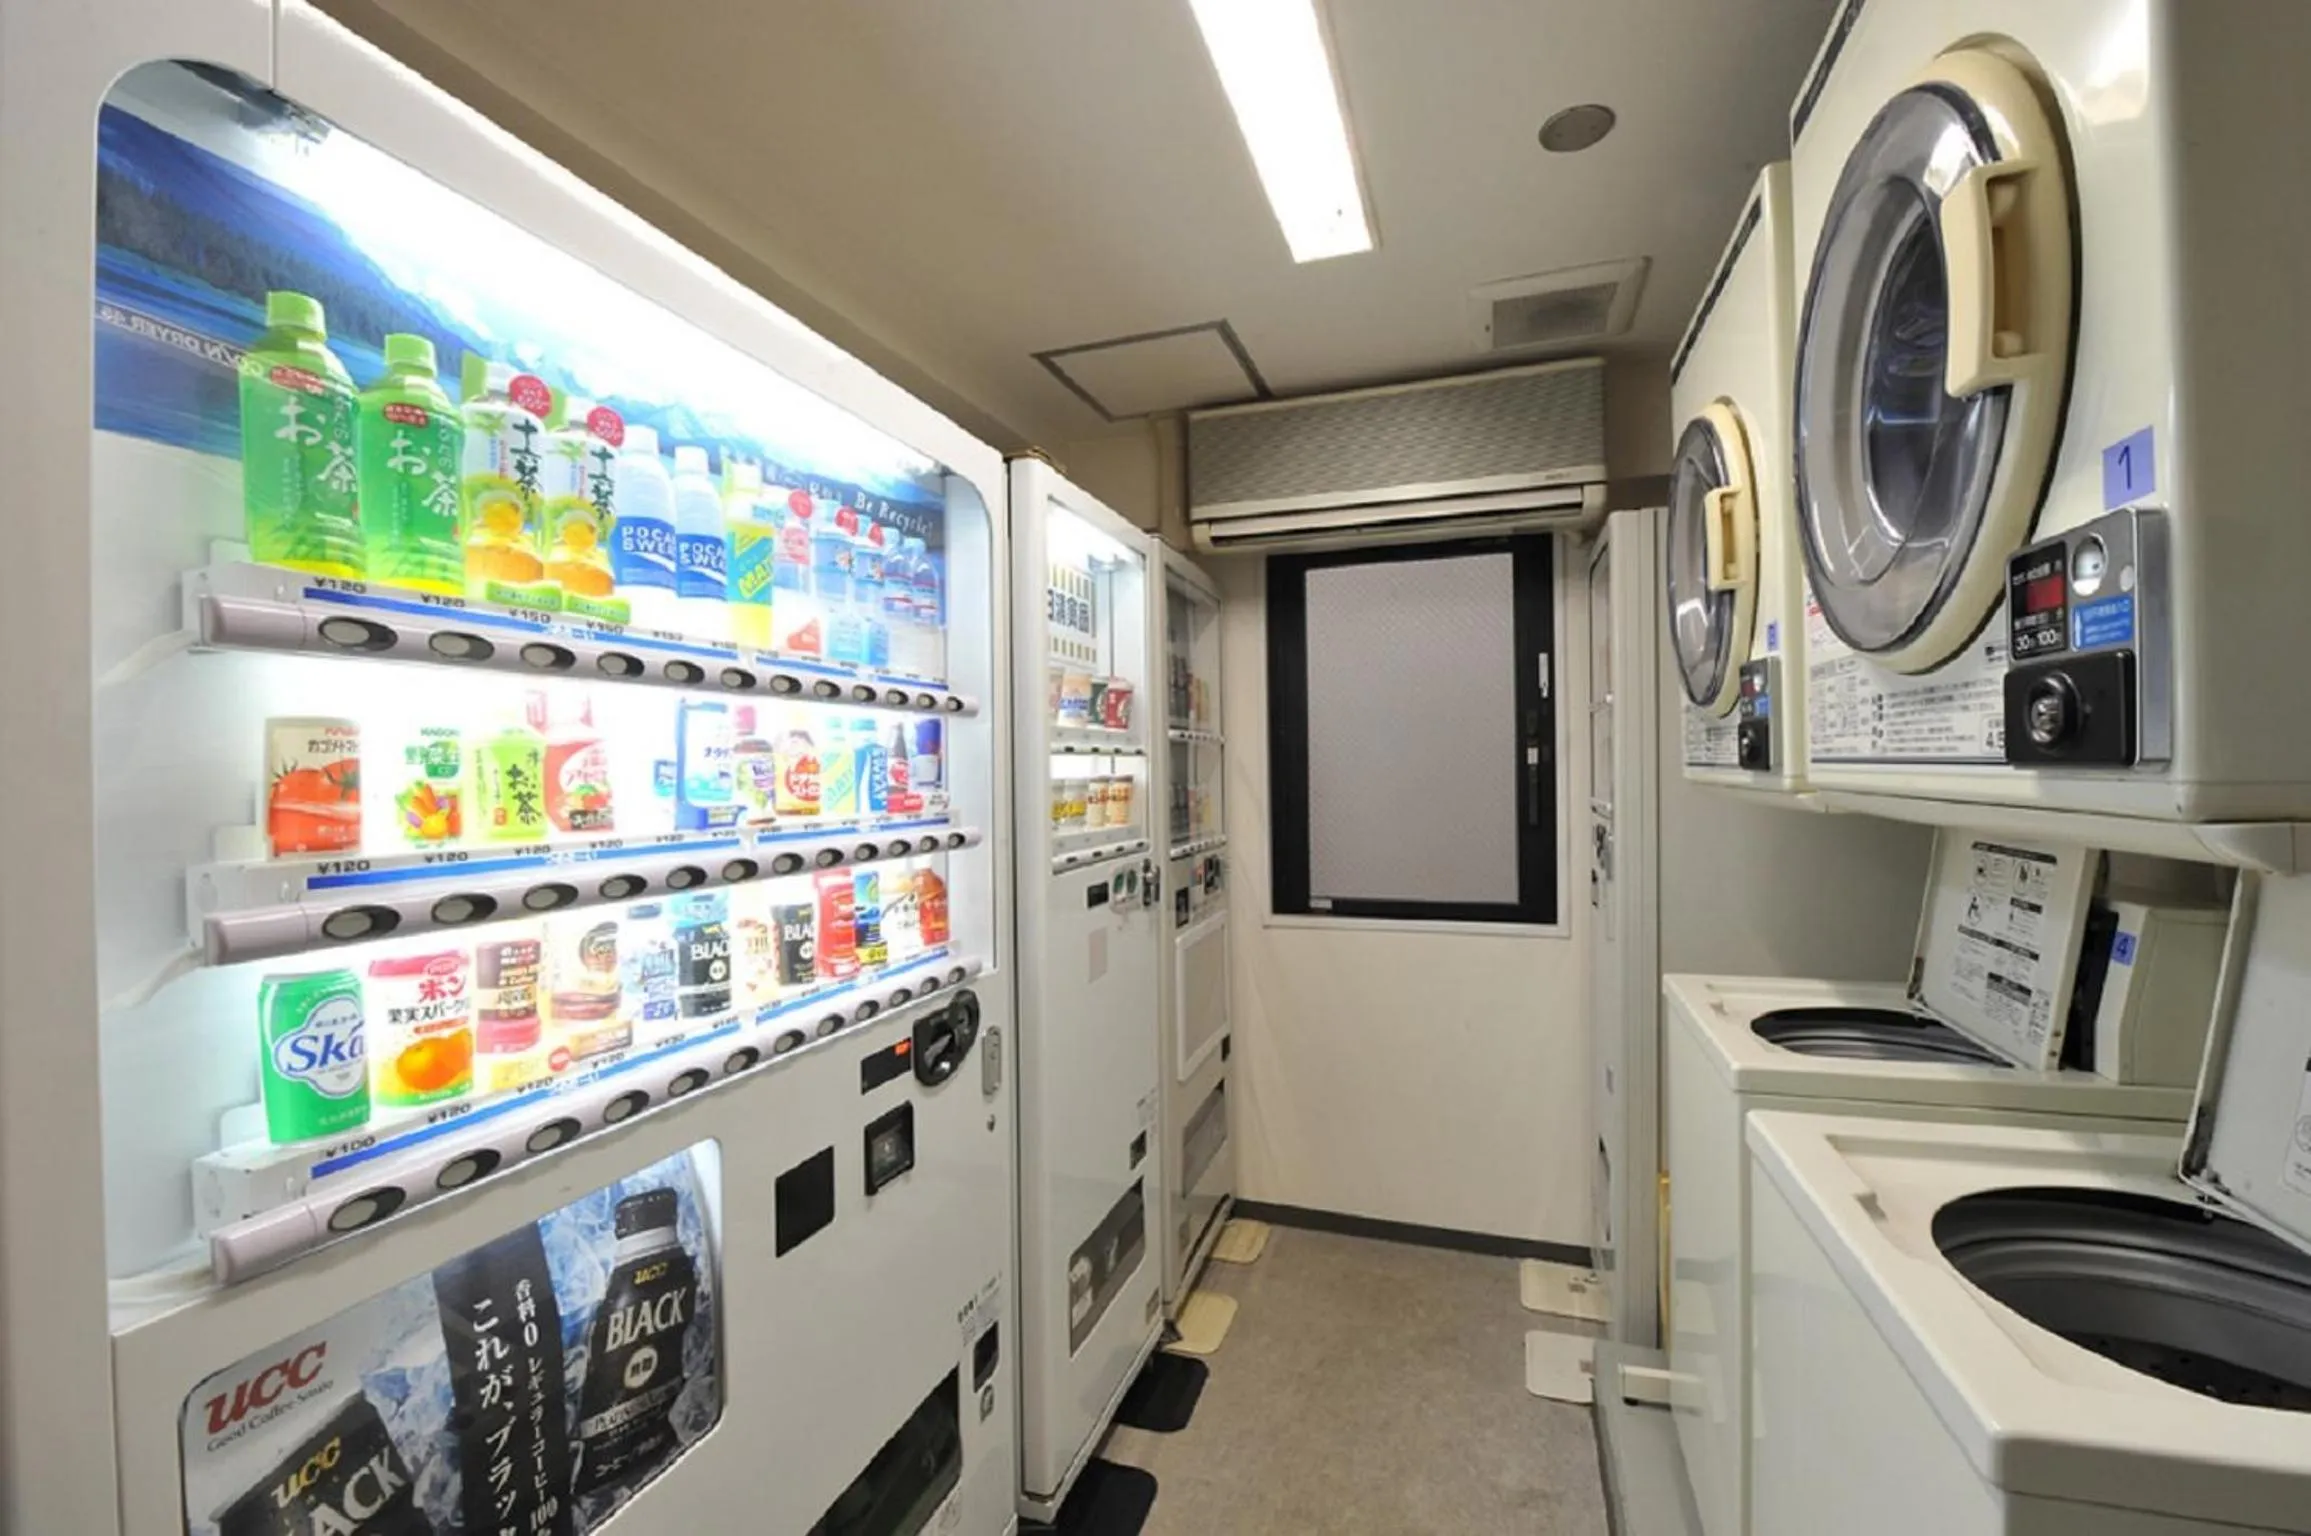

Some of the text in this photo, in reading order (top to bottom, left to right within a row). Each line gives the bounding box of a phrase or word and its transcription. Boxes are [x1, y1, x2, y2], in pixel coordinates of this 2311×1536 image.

[2117, 445, 2132, 490] 1
[314, 577, 367, 595] ¥120
[420, 594, 466, 609] ¥120
[508, 608, 552, 624] ¥150
[424, 851, 469, 864] ¥120
[514, 844, 551, 857] ¥120
[317, 859, 370, 875] ¥120
[2116, 936, 2130, 957] 4
[516, 1075, 553, 1094] ¥120
[427, 1102, 471, 1124] ¥120
[325, 1136, 376, 1158] ¥100
[605, 1286, 687, 1353] BLACK
[205, 1340, 327, 1435] UCC
[207, 1423, 247, 1452] Good
[249, 1402, 295, 1431] Coffee
[270, 1436, 342, 1509] UCC
